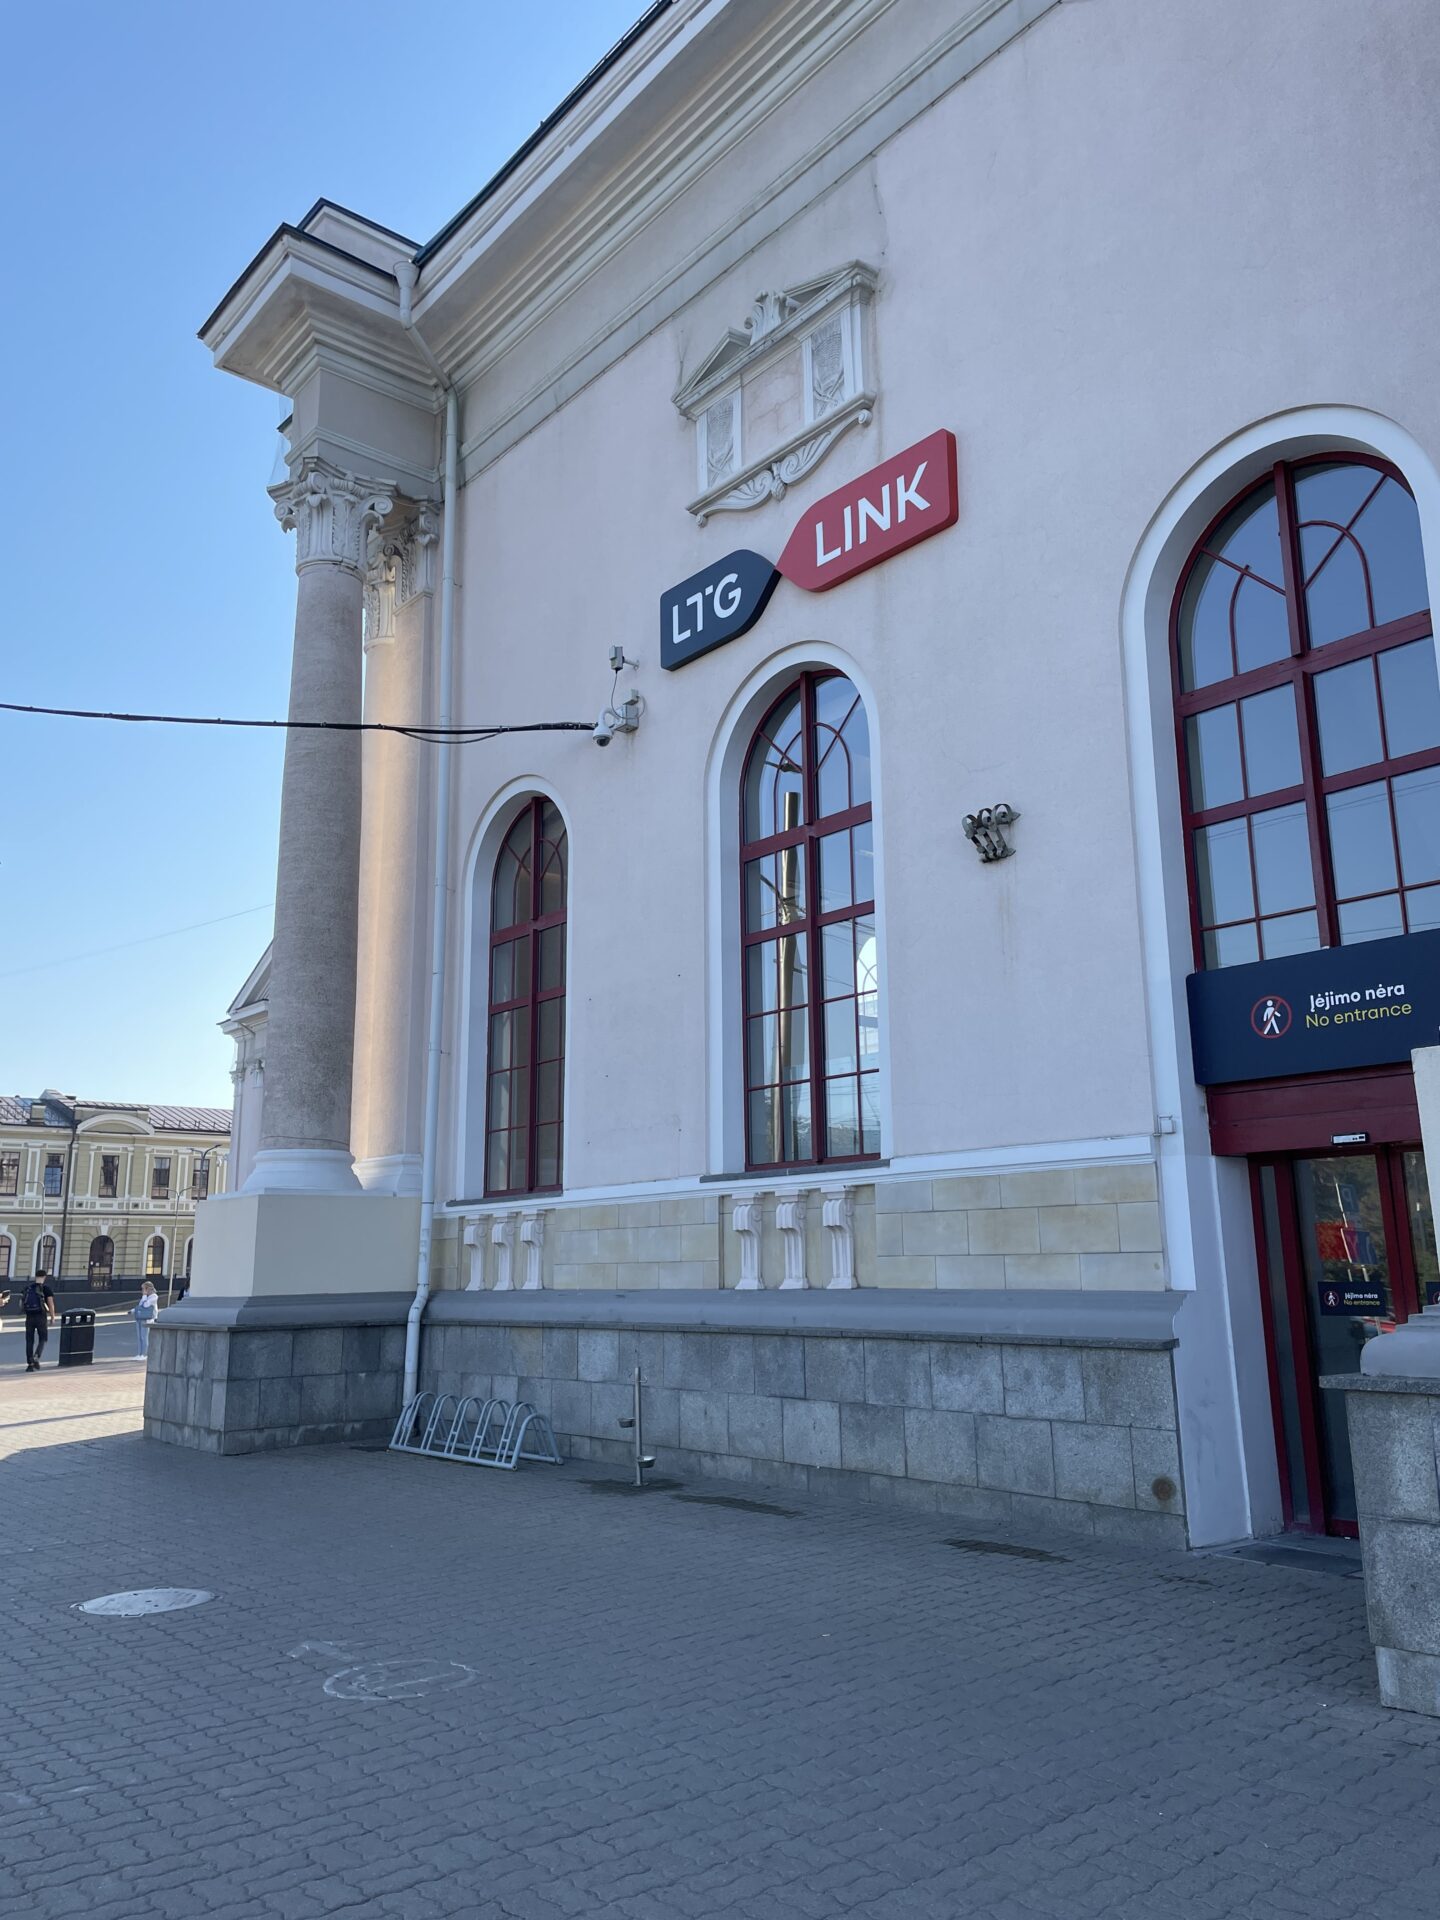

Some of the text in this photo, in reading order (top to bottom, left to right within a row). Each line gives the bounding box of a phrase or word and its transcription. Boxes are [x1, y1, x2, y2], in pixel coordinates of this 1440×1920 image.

[672, 461, 931, 644] LTG LINK
[1310, 984, 1405, 1013] Įėjimo nėra
[1305, 1003, 1412, 1028] No entrance
